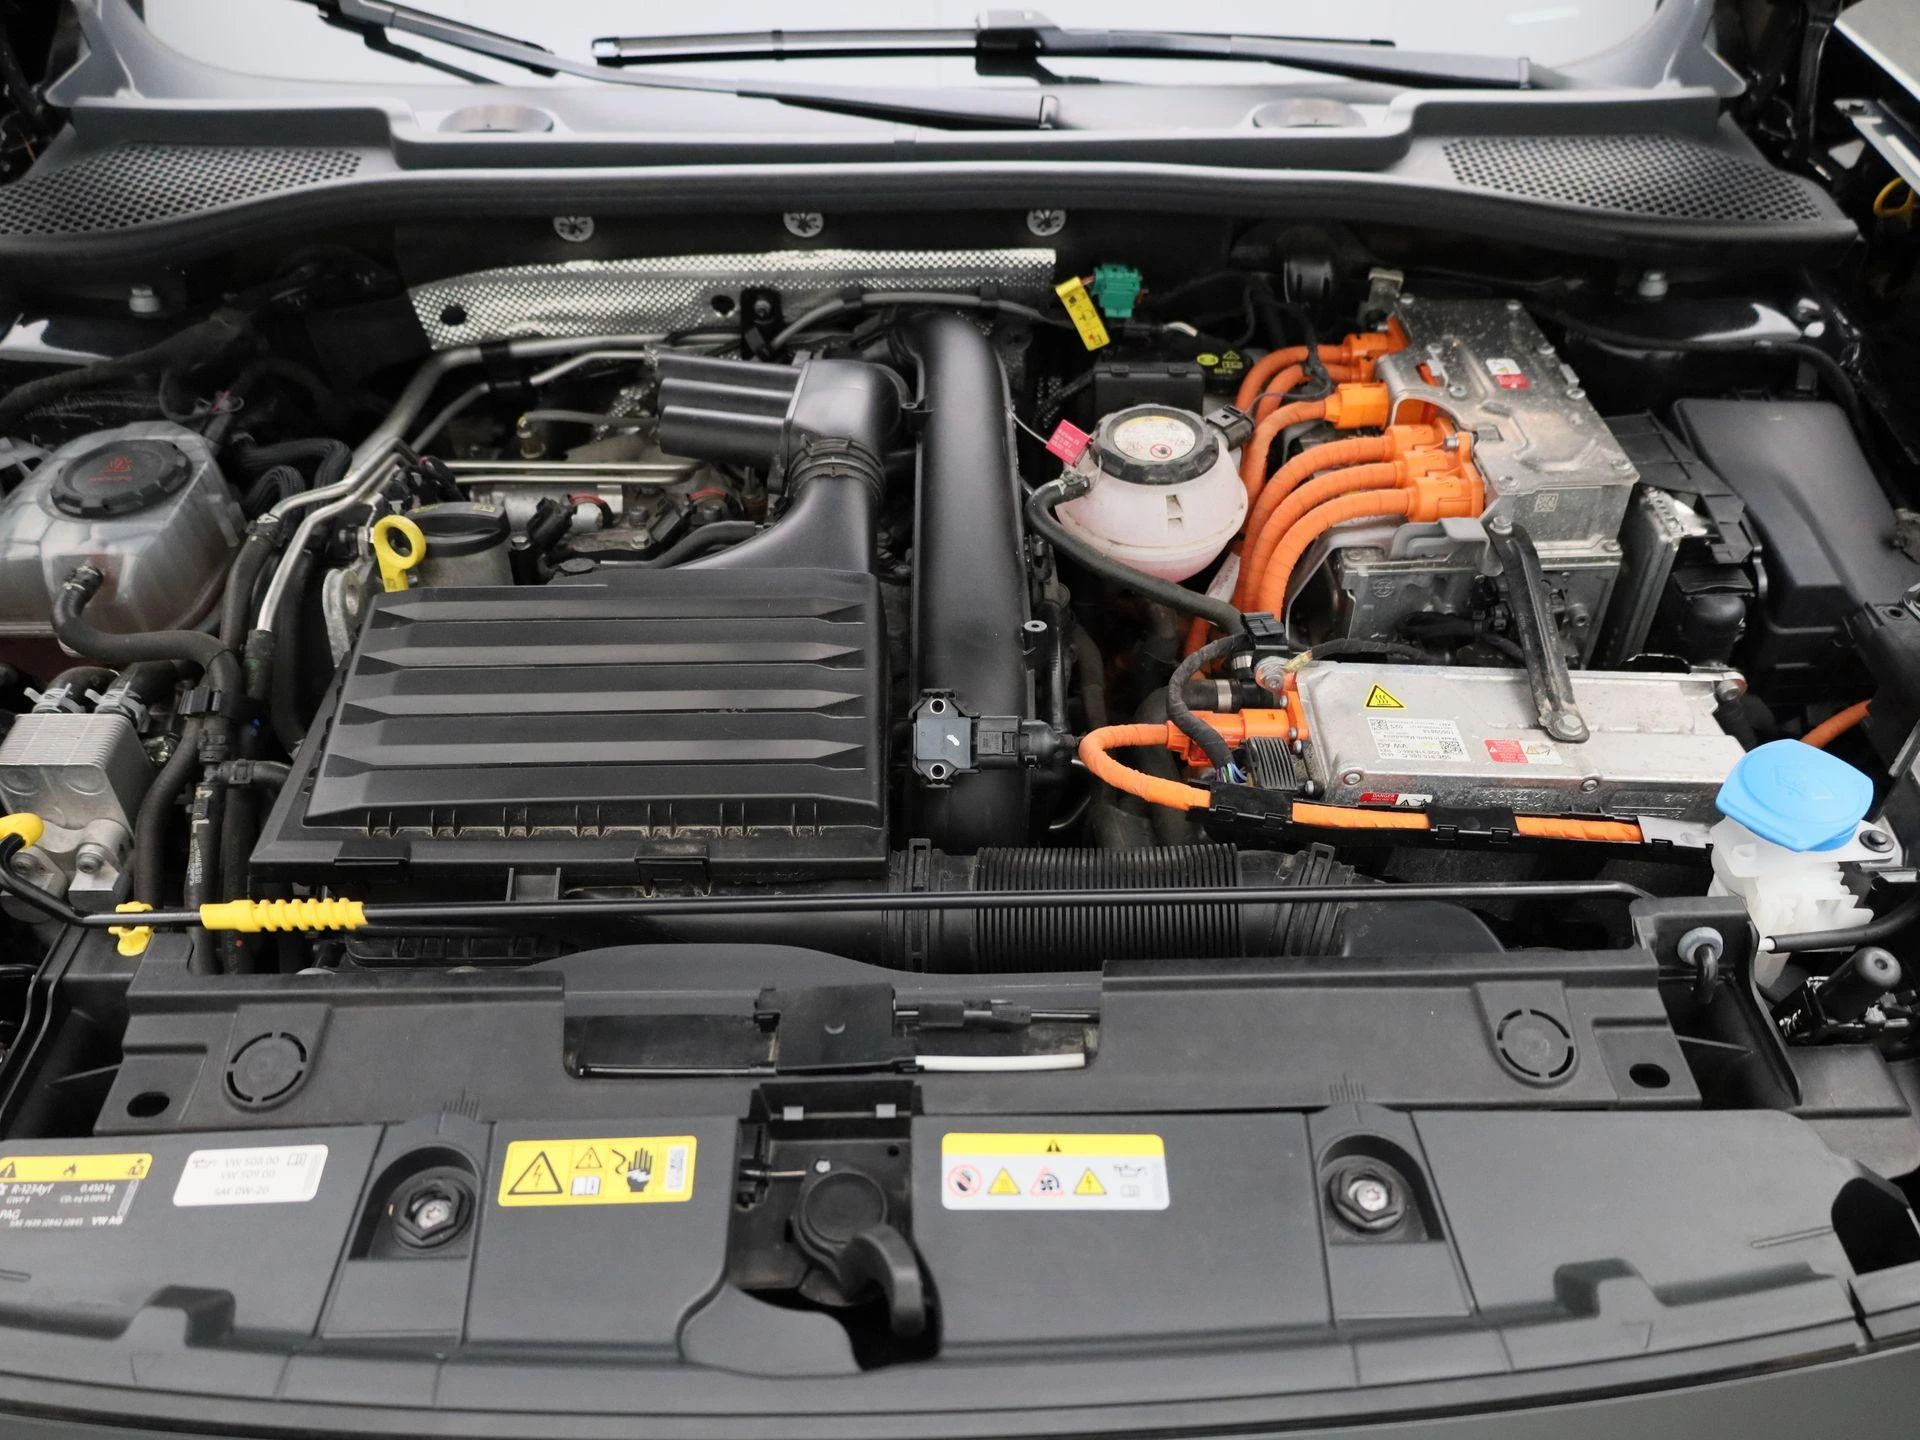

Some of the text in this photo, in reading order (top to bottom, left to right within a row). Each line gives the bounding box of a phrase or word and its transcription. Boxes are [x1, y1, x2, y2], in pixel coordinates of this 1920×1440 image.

[225, 1157, 241, 1167] VW
[221, 1169, 239, 1180] VW
[11, 1183, 55, 1197] R-1234yf
[104, 1183, 116, 1194] kg
[0, 1208, 21, 1220] PAG
[91, 1216, 108, 1226] VW
[108, 1215, 123, 1226] AG
